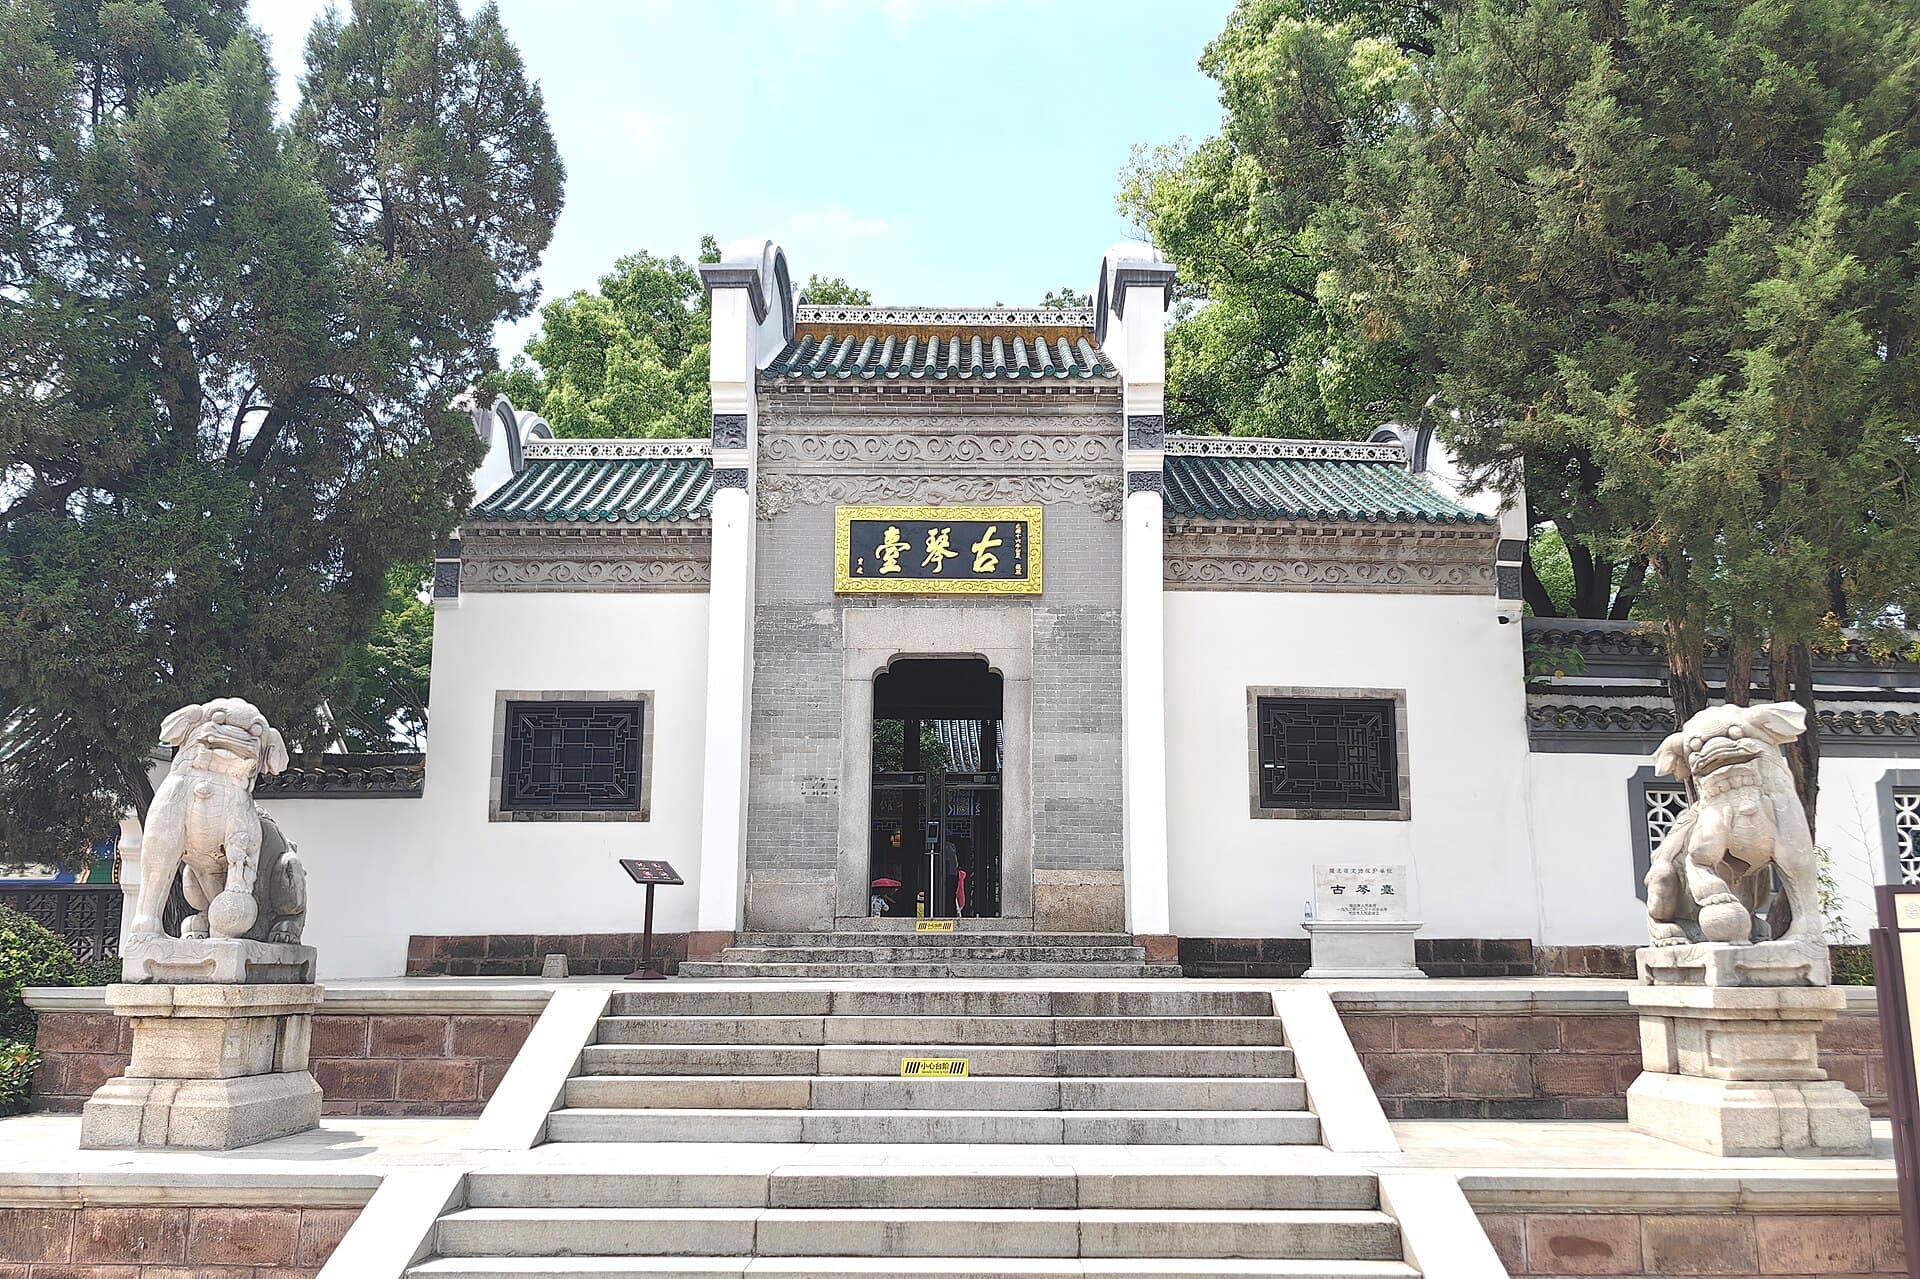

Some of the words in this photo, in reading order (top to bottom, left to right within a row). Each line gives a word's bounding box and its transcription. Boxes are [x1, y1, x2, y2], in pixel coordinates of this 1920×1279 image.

[875, 525, 1002, 574] 古琴臺
[1330, 884, 1395, 895] 古琴臺
